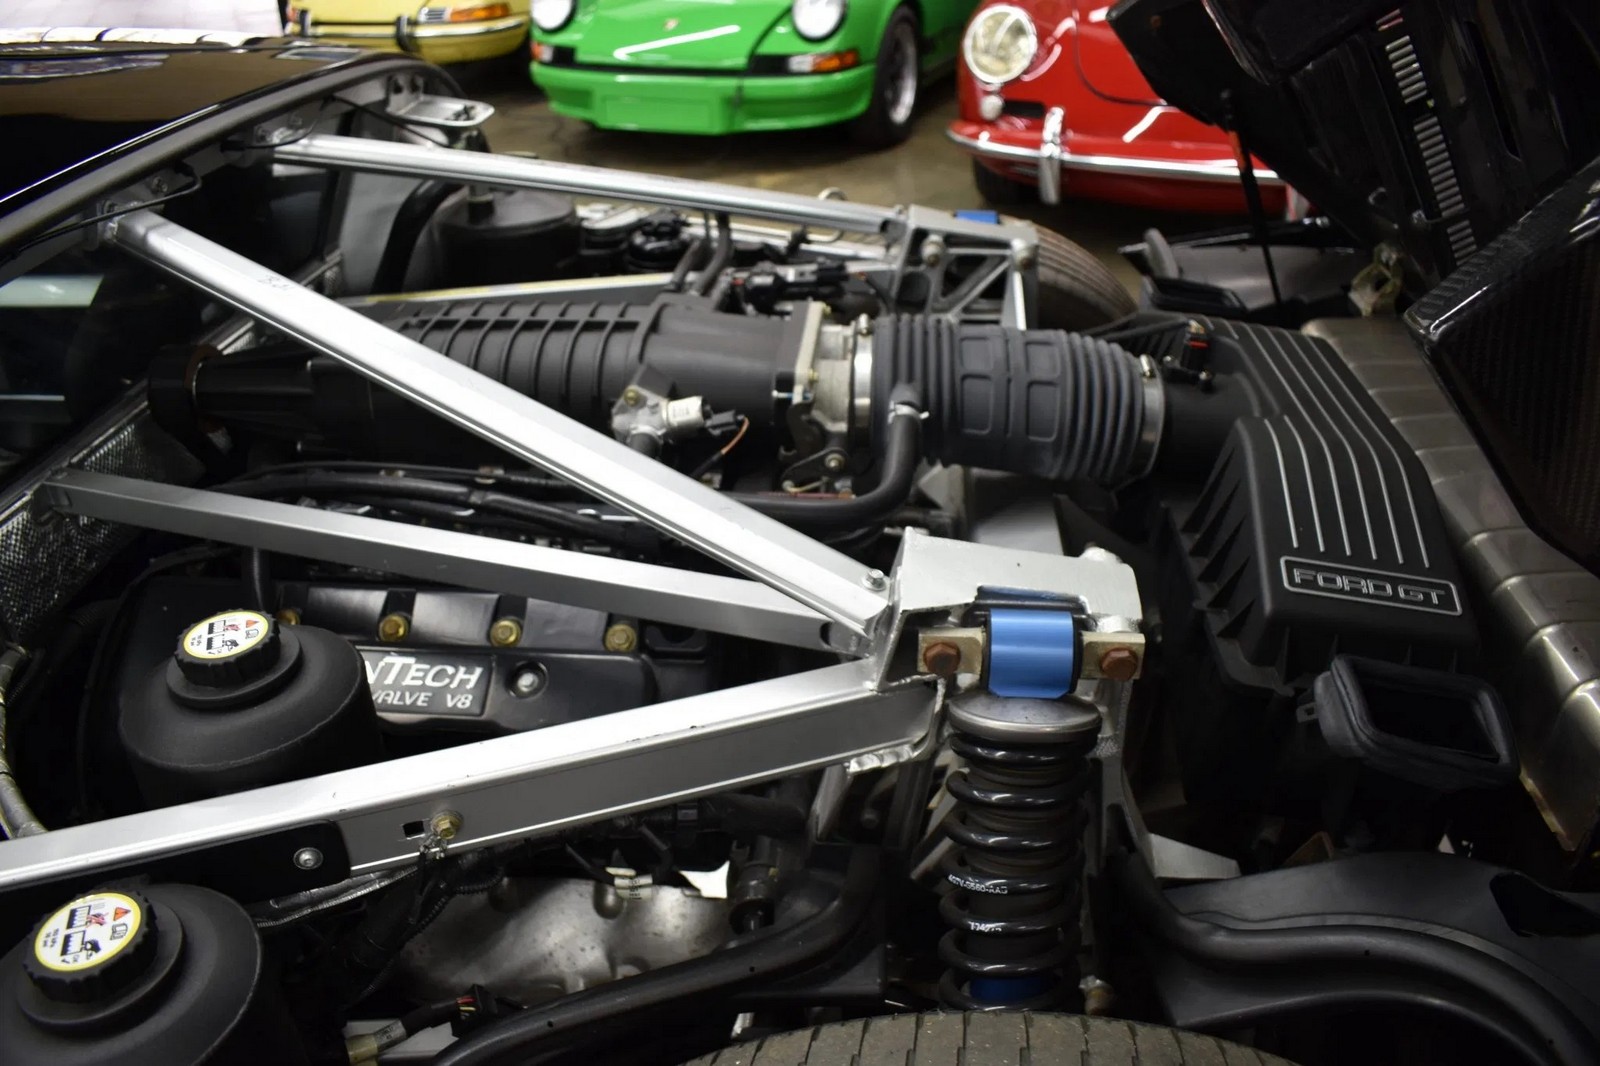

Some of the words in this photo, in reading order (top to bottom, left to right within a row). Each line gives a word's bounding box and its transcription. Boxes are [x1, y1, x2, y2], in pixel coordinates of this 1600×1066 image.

[1293, 567, 1393, 598] FORD
[1398, 584, 1446, 605] GT
[446, 692, 474, 709] V8
